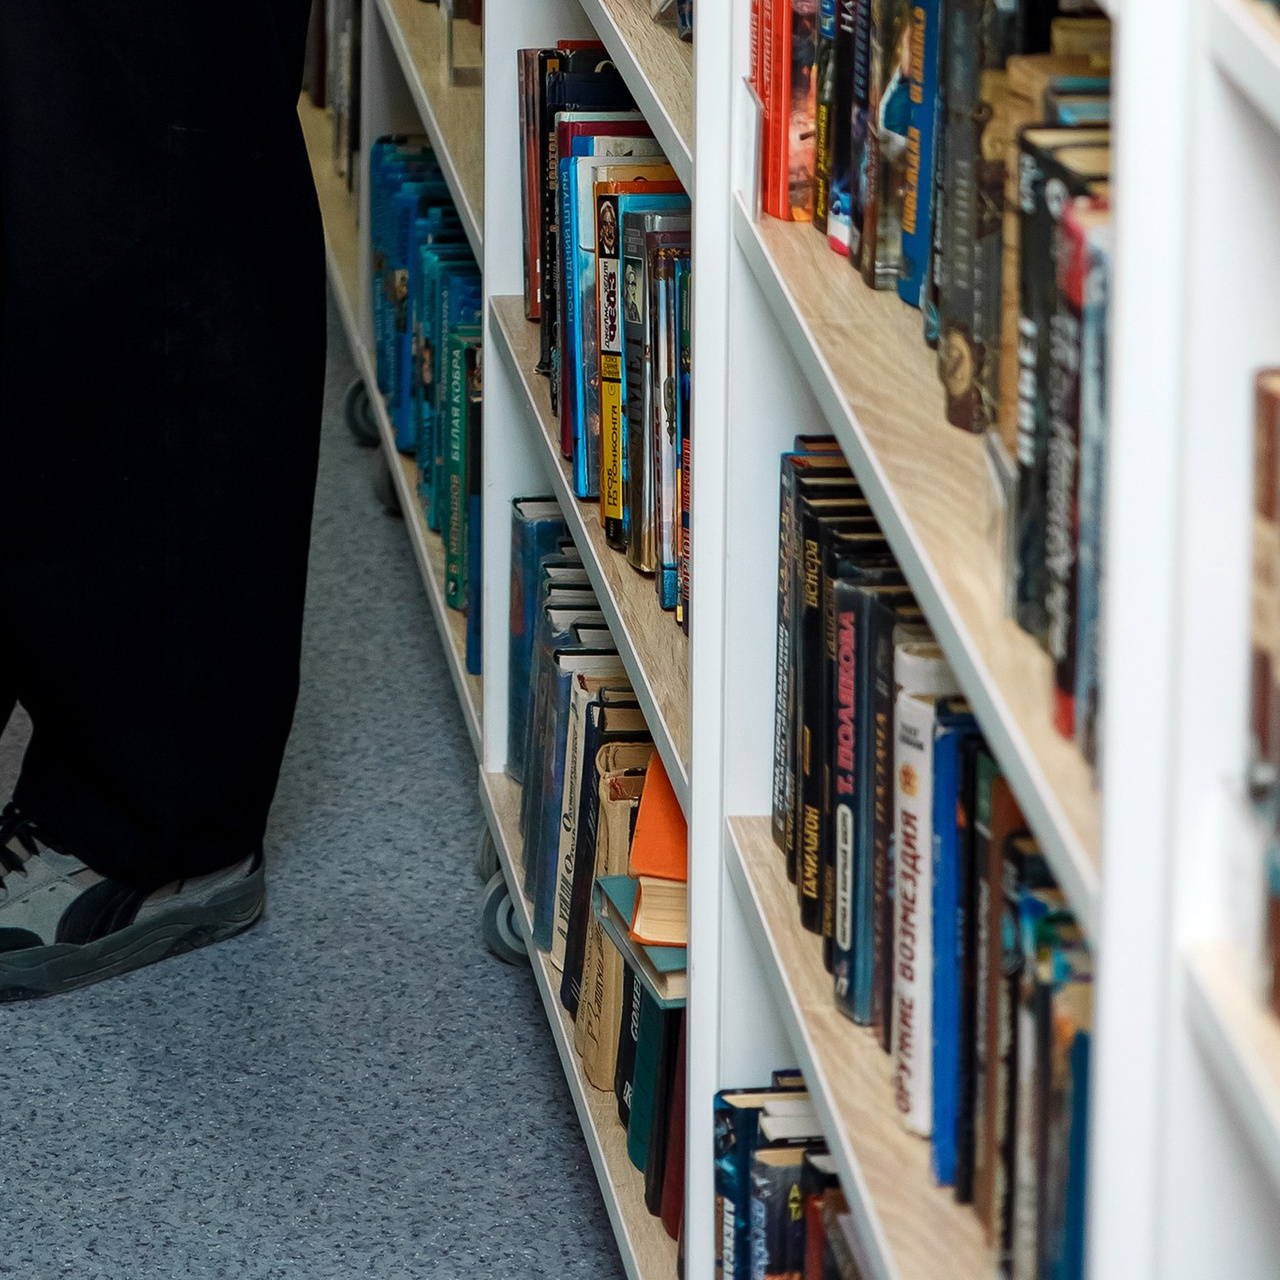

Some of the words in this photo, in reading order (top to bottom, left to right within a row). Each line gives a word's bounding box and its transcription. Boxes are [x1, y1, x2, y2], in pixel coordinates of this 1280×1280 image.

[562, 171, 572, 225] ШТУРМ
[563, 228, 575, 322] ПОСЛЕДНИЙ
[451, 349, 462, 404] КОБРА
[449, 407, 460, 462] БЕЛАЯ
[611, 489, 618, 507] ИЗ
[837, 611, 855, 771] ПОЛЯКОВА
[802, 803, 820, 899] ГАМИЛЬТОН
[895, 809, 921, 982] ВОЗМЕЗДИЯ
